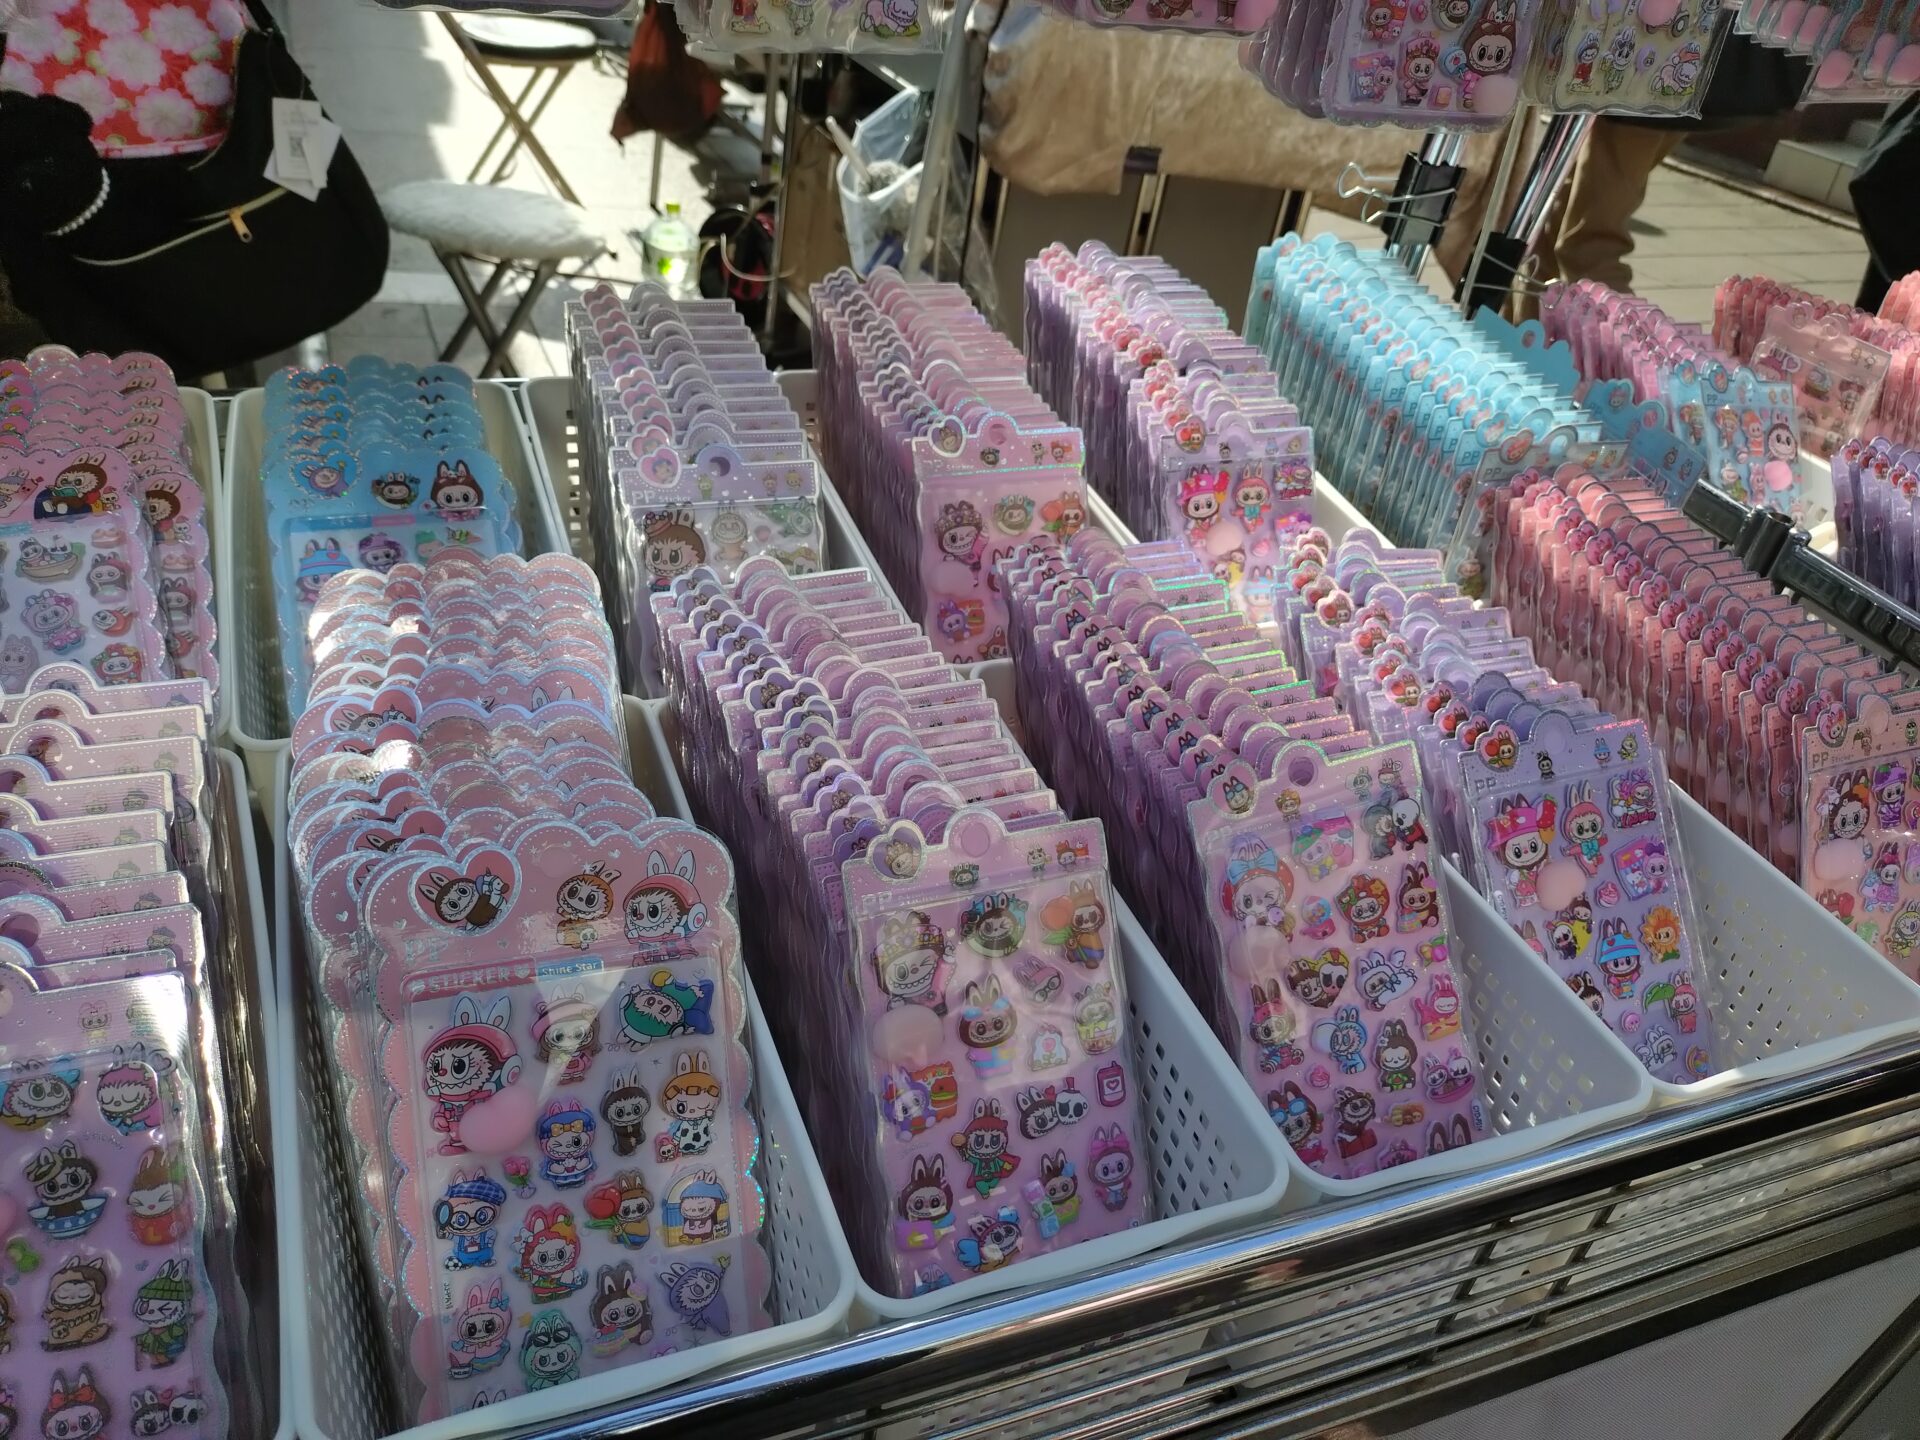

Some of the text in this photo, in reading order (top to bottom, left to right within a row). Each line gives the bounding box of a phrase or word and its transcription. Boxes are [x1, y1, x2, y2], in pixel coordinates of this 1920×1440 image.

[1463, 451, 1480, 463] PP
[1485, 467, 1502, 478] PP
[632, 490, 656, 505] PP
[1774, 727, 1790, 744] PP
[1812, 751, 1829, 768] PP
[1475, 777, 1496, 792] PP
[542, 966, 573, 977] Shine
[576, 962, 598, 973] Star
